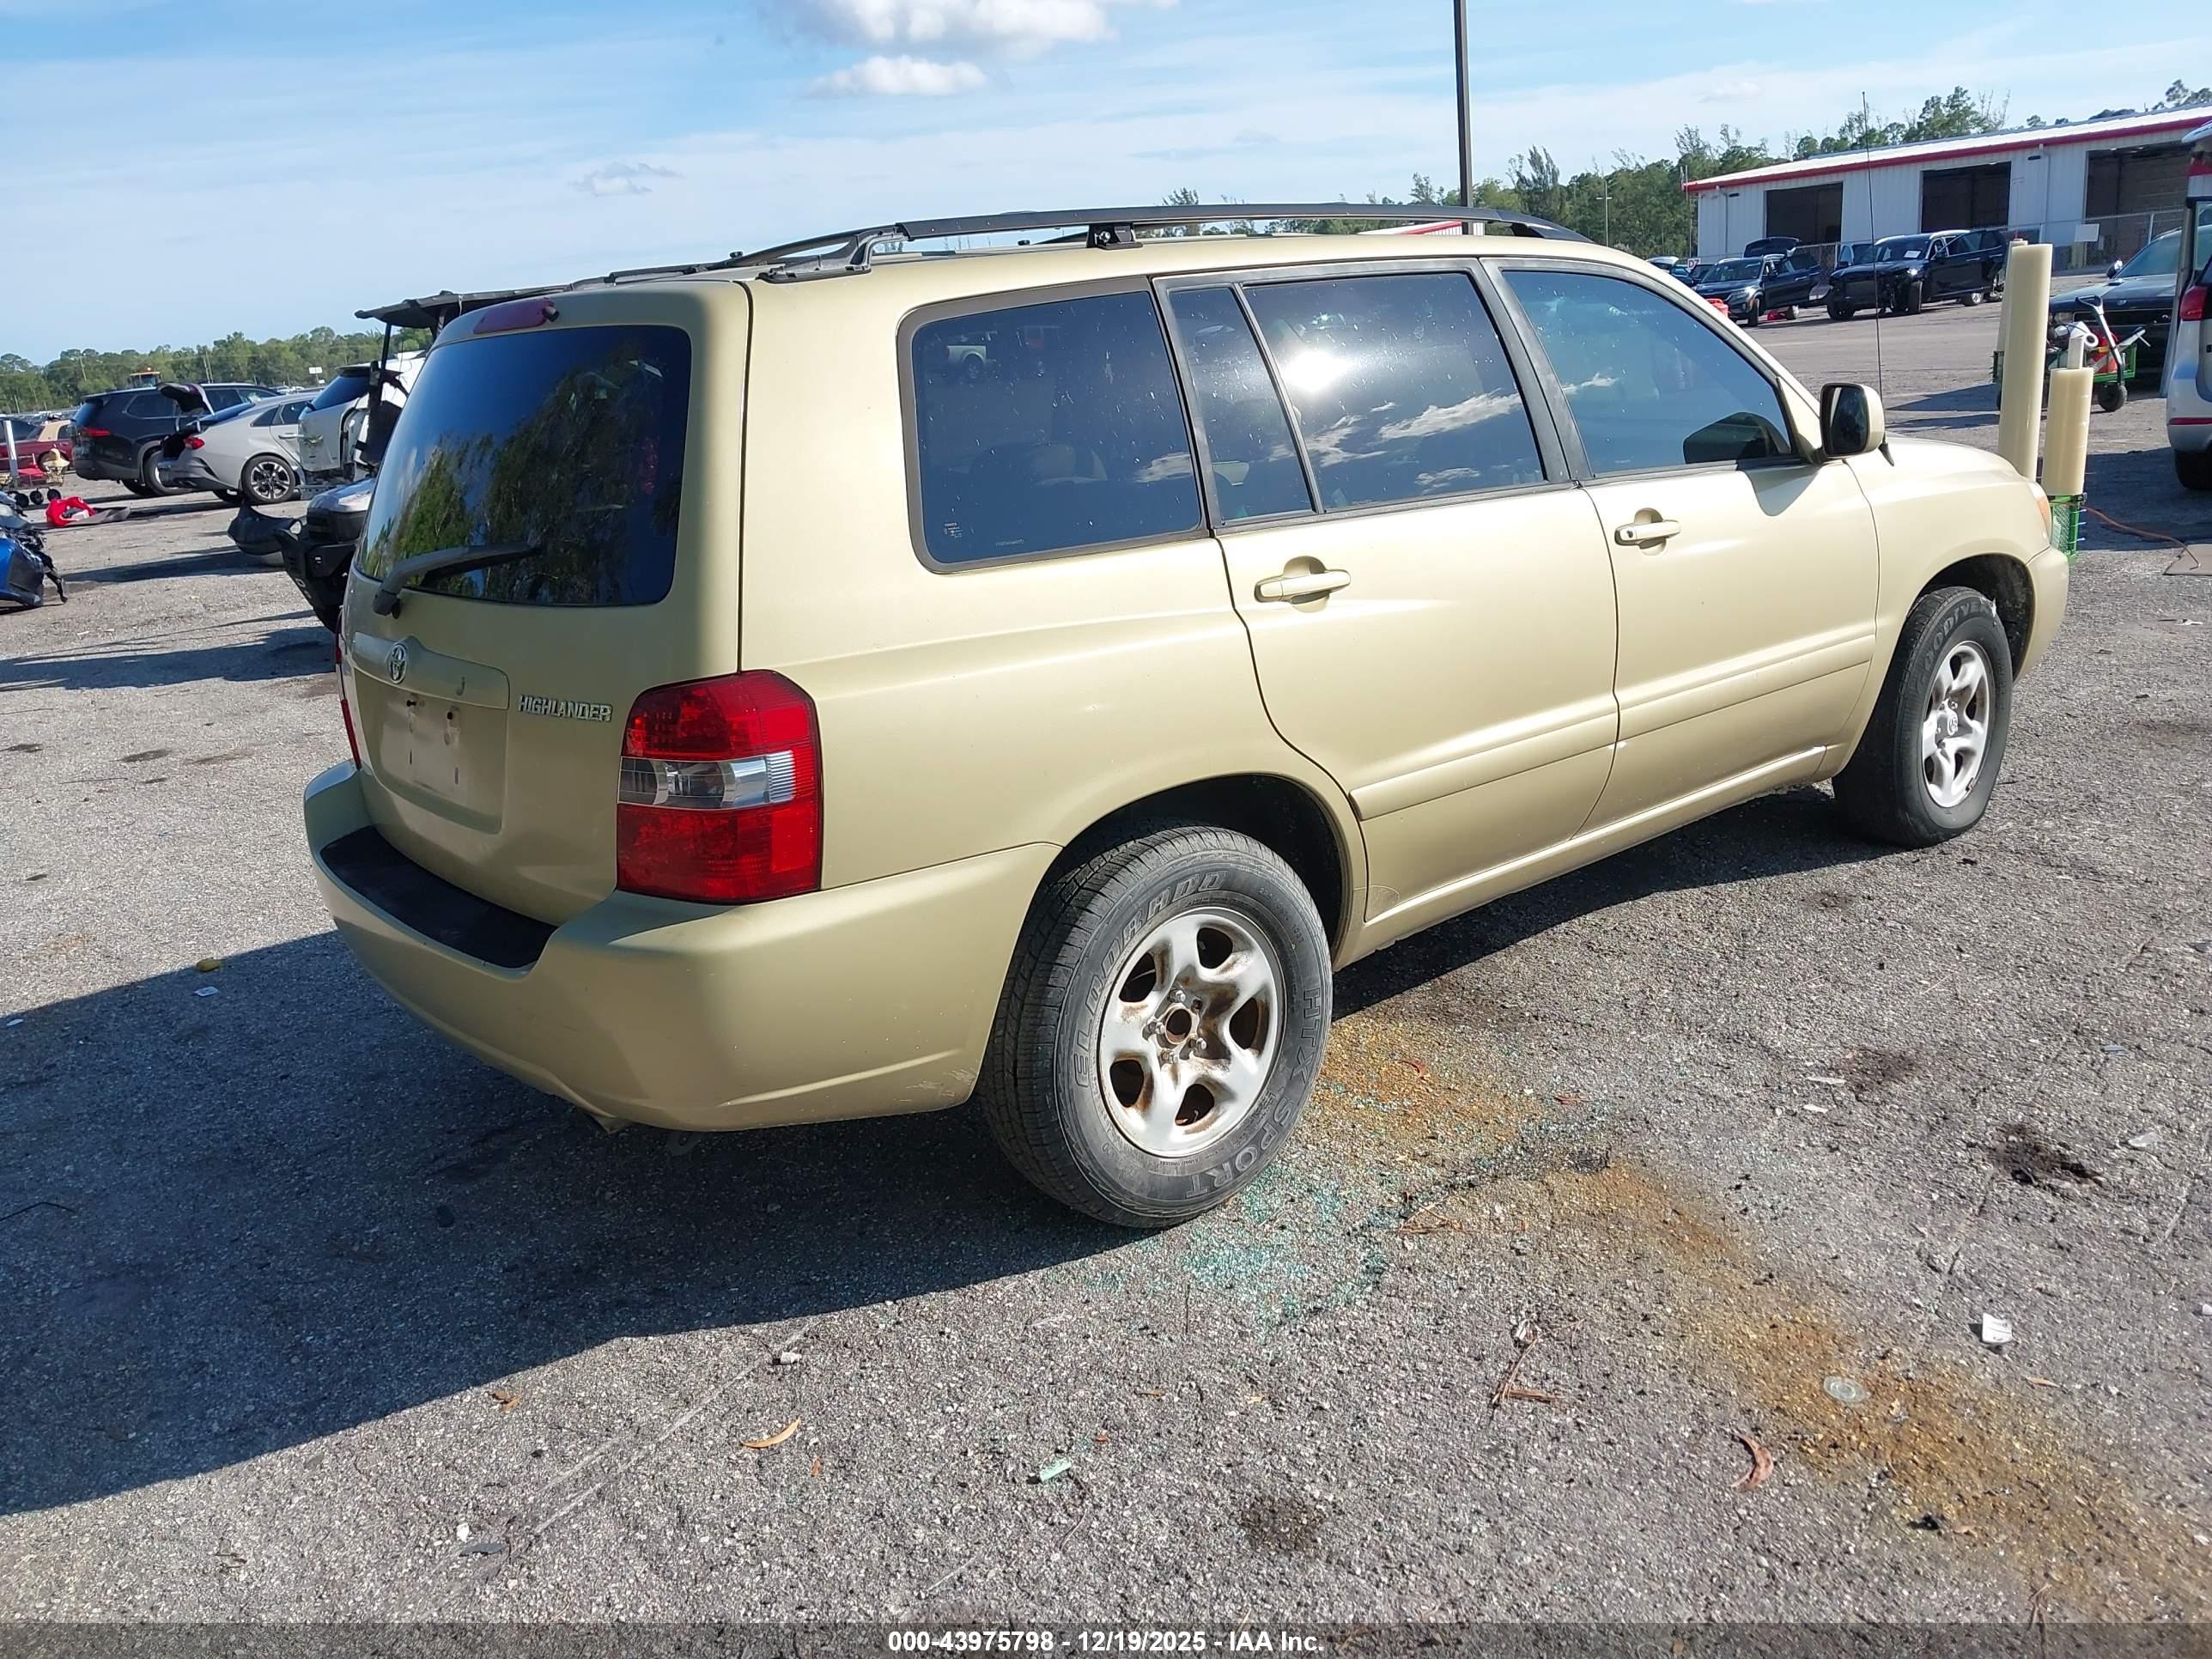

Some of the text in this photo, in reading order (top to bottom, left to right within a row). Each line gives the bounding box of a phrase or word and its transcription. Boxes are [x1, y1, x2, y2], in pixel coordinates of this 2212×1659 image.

[518, 695, 612, 722] HIGHLANDER
[1289, 988, 1322, 1085] HTX
[1185, 1096, 1296, 1200] SPORT
